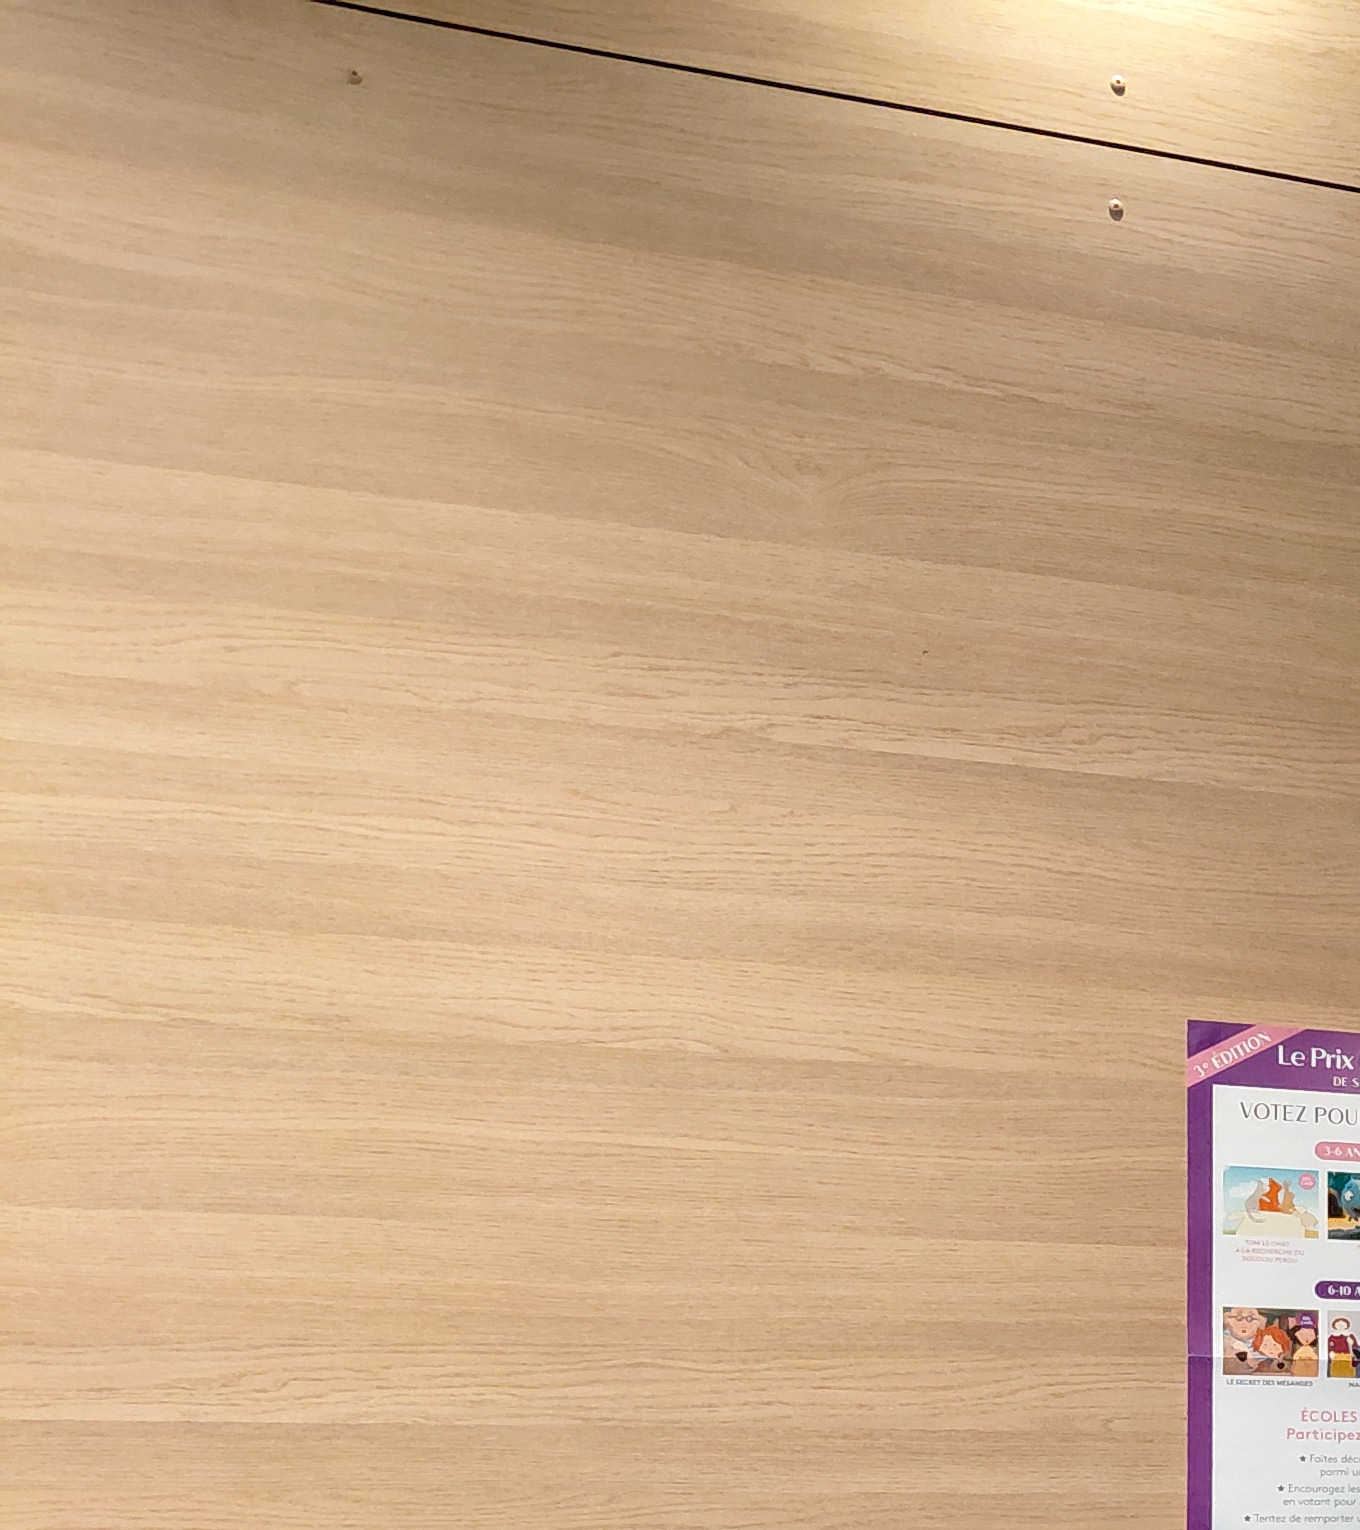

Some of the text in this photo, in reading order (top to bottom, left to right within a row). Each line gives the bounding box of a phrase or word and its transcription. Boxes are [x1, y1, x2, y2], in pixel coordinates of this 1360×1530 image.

[1211, 1032, 1272, 1069] ÉDITION
[1277, 1044, 1305, 1067] Le
[1310, 1046, 1354, 1071] Prix
[1332, 1075, 1348, 1087] DE
[1240, 1101, 1307, 1123] VOTEZ
[1323, 1145, 1343, 1157] 3-6
[1328, 1284, 1351, 1296] 6-10
[1301, 1407, 1358, 1423] ÉCOLES
[1309, 1454, 1338, 1464] Faites
[1319, 1469, 1349, 1479] parmi
[1288, 1483, 1345, 1495] Encouragez
[1348, 1484, 1360, 1494] les
[1283, 1498, 1295, 1506] en
[1297, 1498, 1331, 1506] votant
[1334, 1498, 1357, 1508] pour
[1253, 1513, 1286, 1523] Tentez
[1289, 1513, 1301, 1523] de
[1304, 1514, 1354, 1525] remporter
